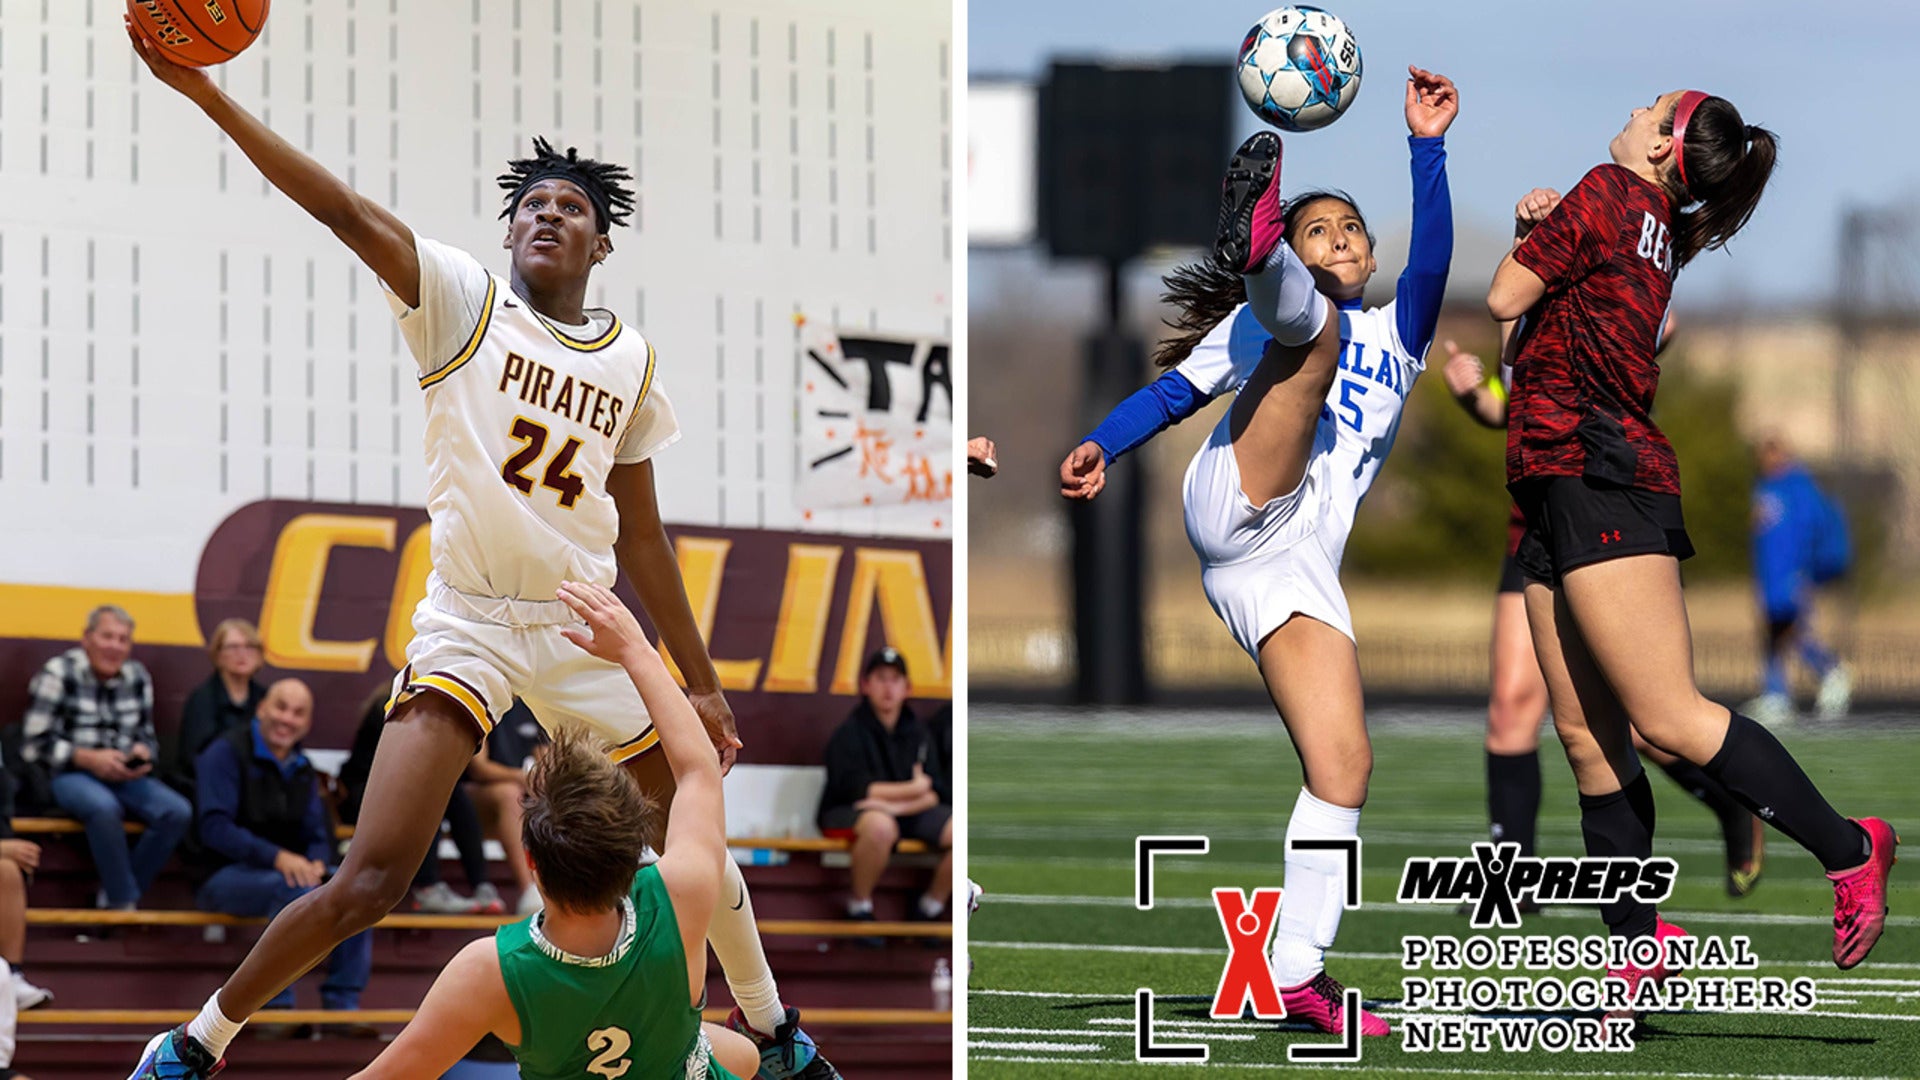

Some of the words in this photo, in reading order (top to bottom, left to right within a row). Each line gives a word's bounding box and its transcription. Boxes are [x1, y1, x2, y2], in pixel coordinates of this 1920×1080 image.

[498, 351, 624, 439] PIRATES
[502, 414, 585, 511] 24
[584, 1025, 633, 1080] 2
